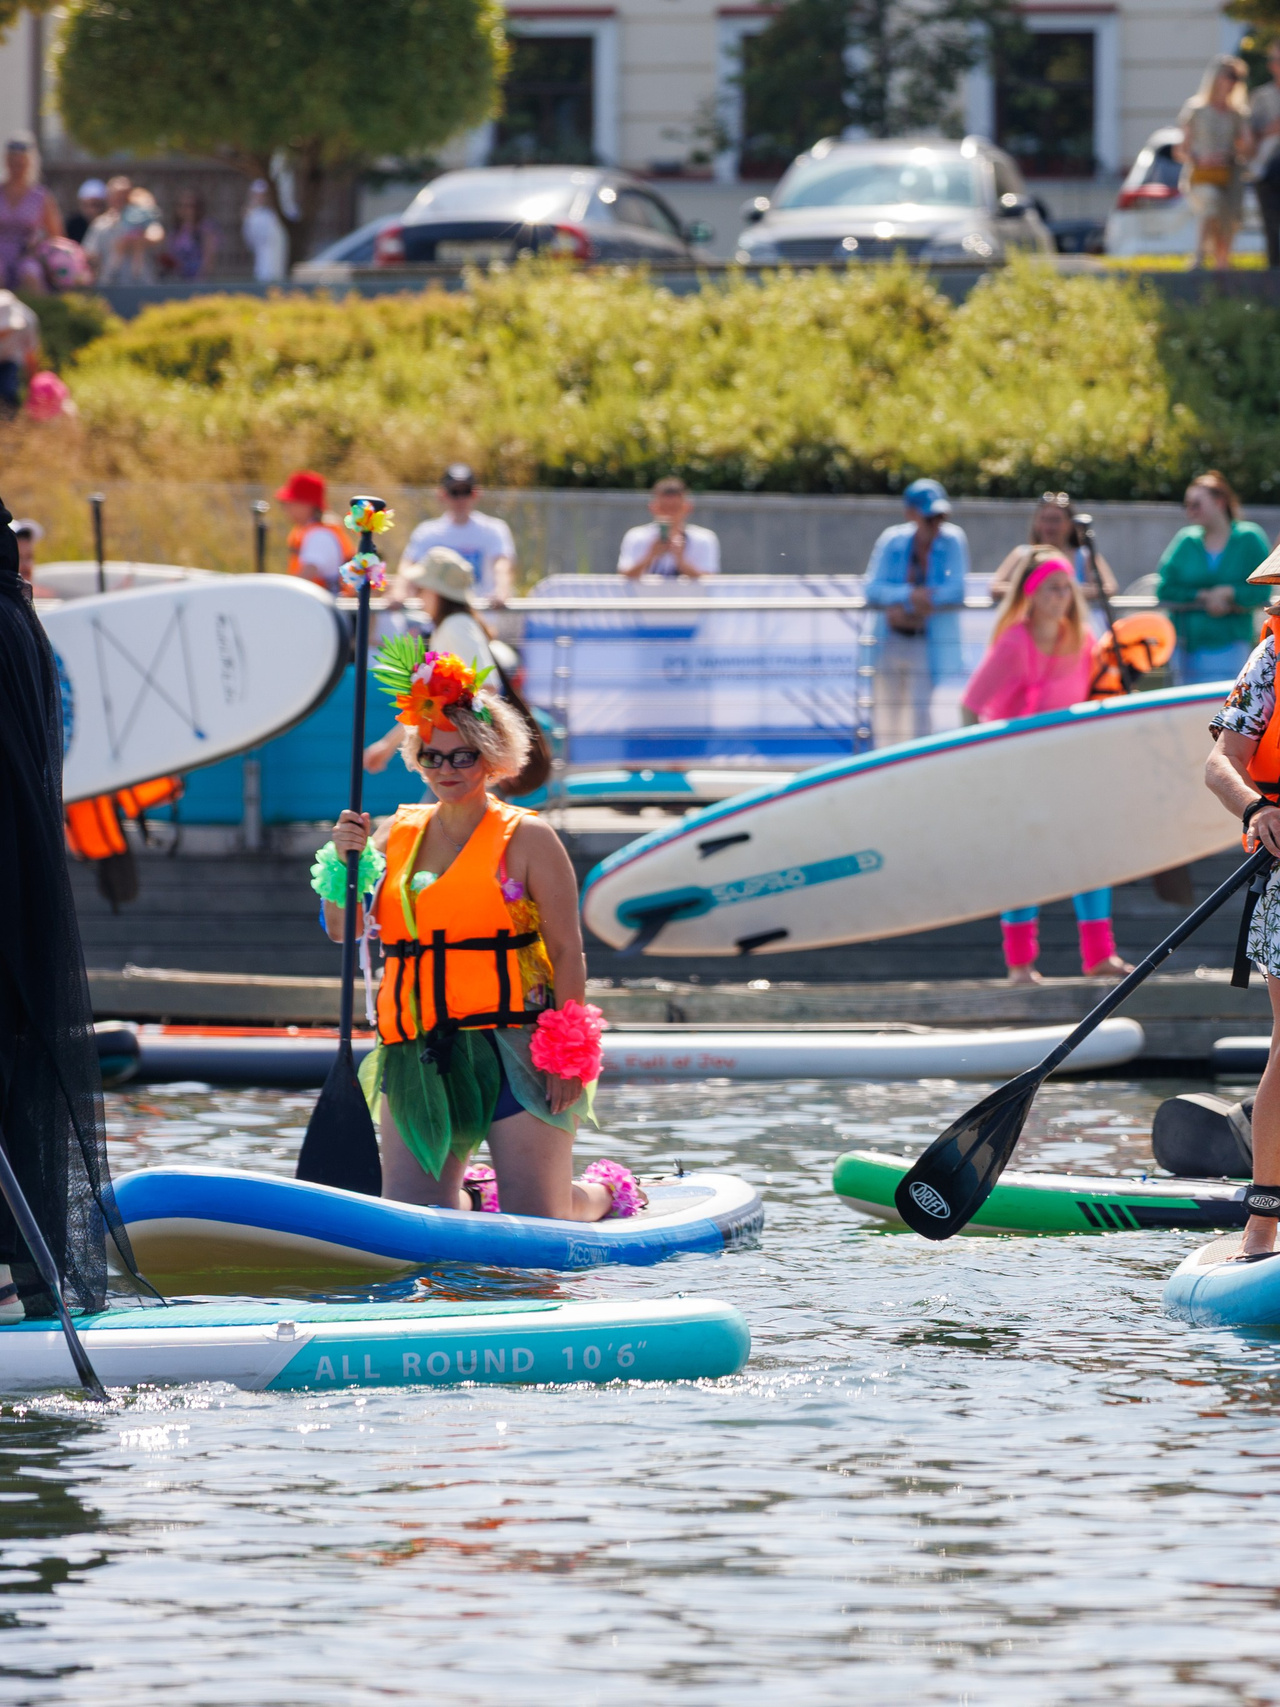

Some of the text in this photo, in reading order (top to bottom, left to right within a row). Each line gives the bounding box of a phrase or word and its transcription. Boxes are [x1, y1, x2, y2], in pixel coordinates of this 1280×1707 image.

[911, 1185, 947, 1214] DRIFT
[314, 1354, 381, 1381] ALL
[402, 1347, 536, 1378] ROUND
